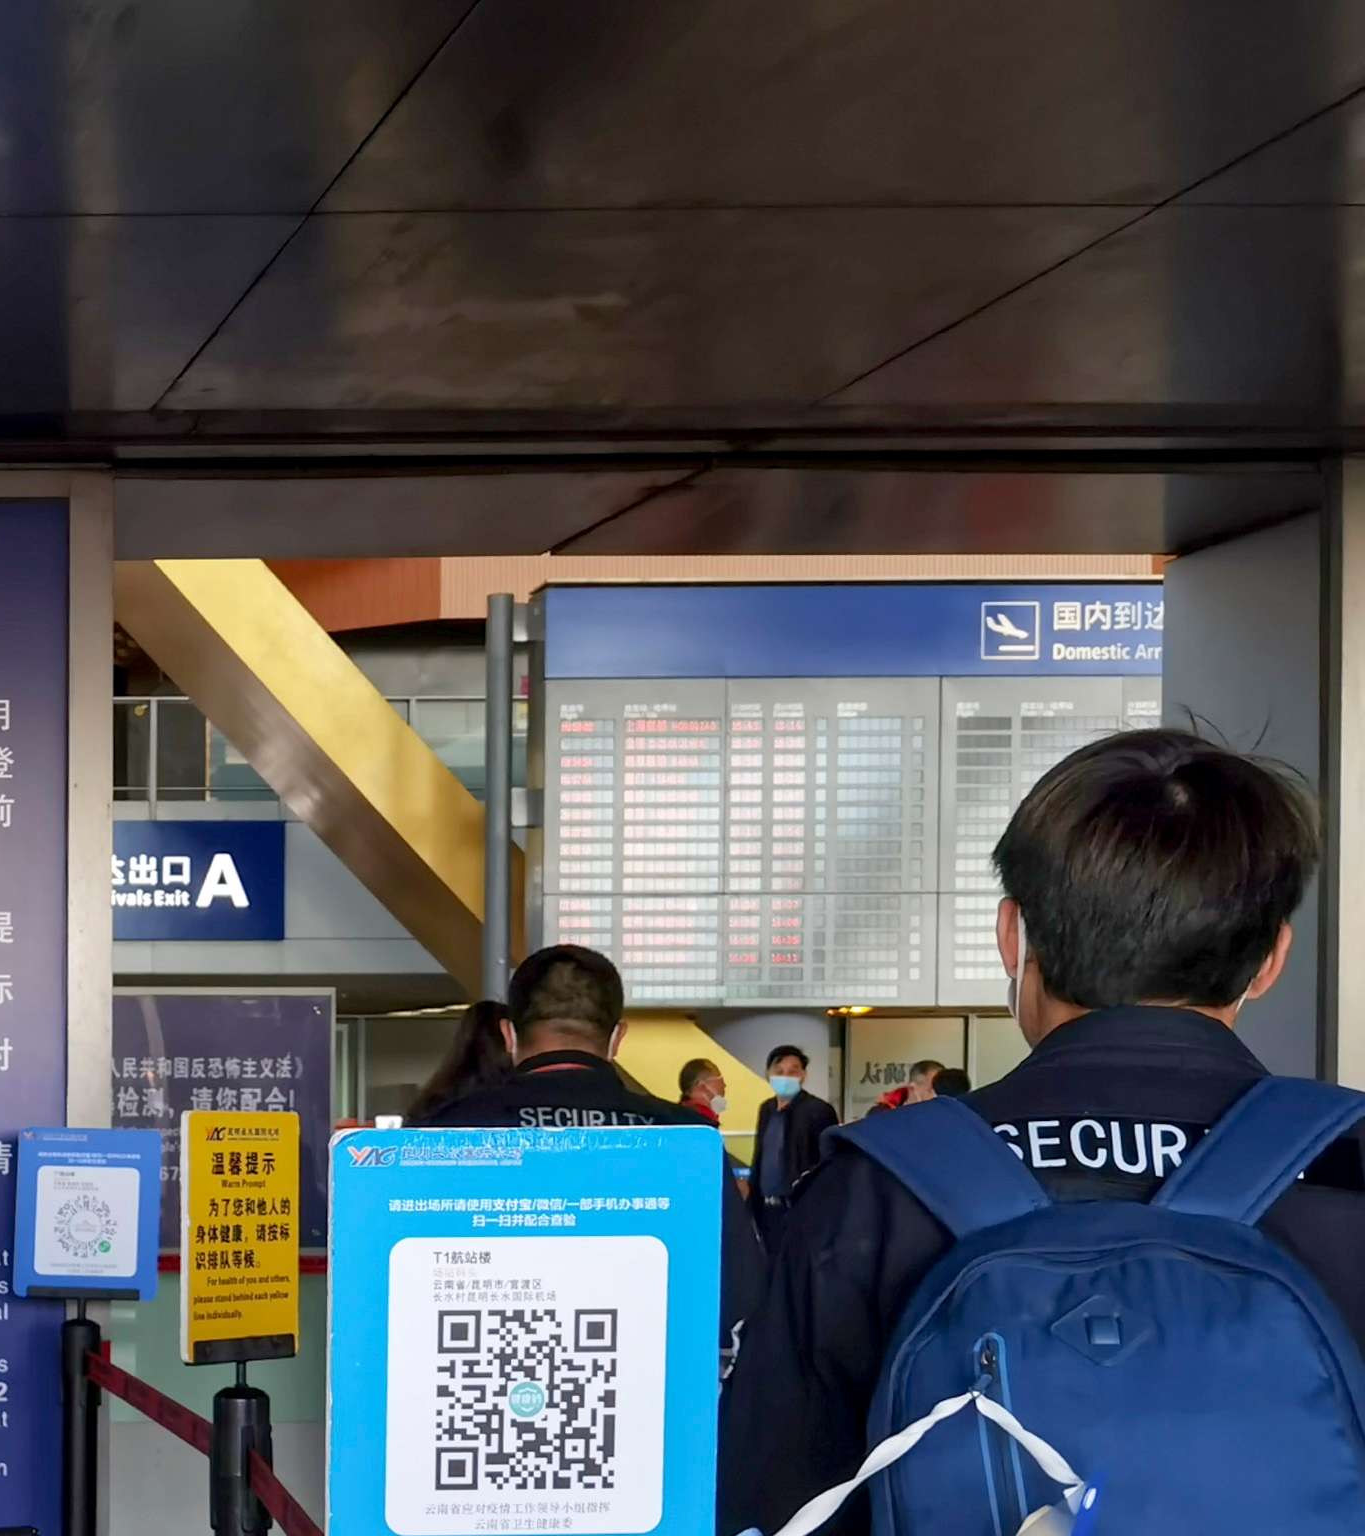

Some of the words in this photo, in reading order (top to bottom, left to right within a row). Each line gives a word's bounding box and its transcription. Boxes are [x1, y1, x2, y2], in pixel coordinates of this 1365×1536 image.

[1052, 643, 1131, 661] Domestic
[195, 853, 250, 908] A
[111, 889, 152, 907] ivals
[153, 889, 190, 907] Exit
[111, 1086, 295, 1118] 检测，请您配合!
[993, 1119, 1190, 1178] SECUR
